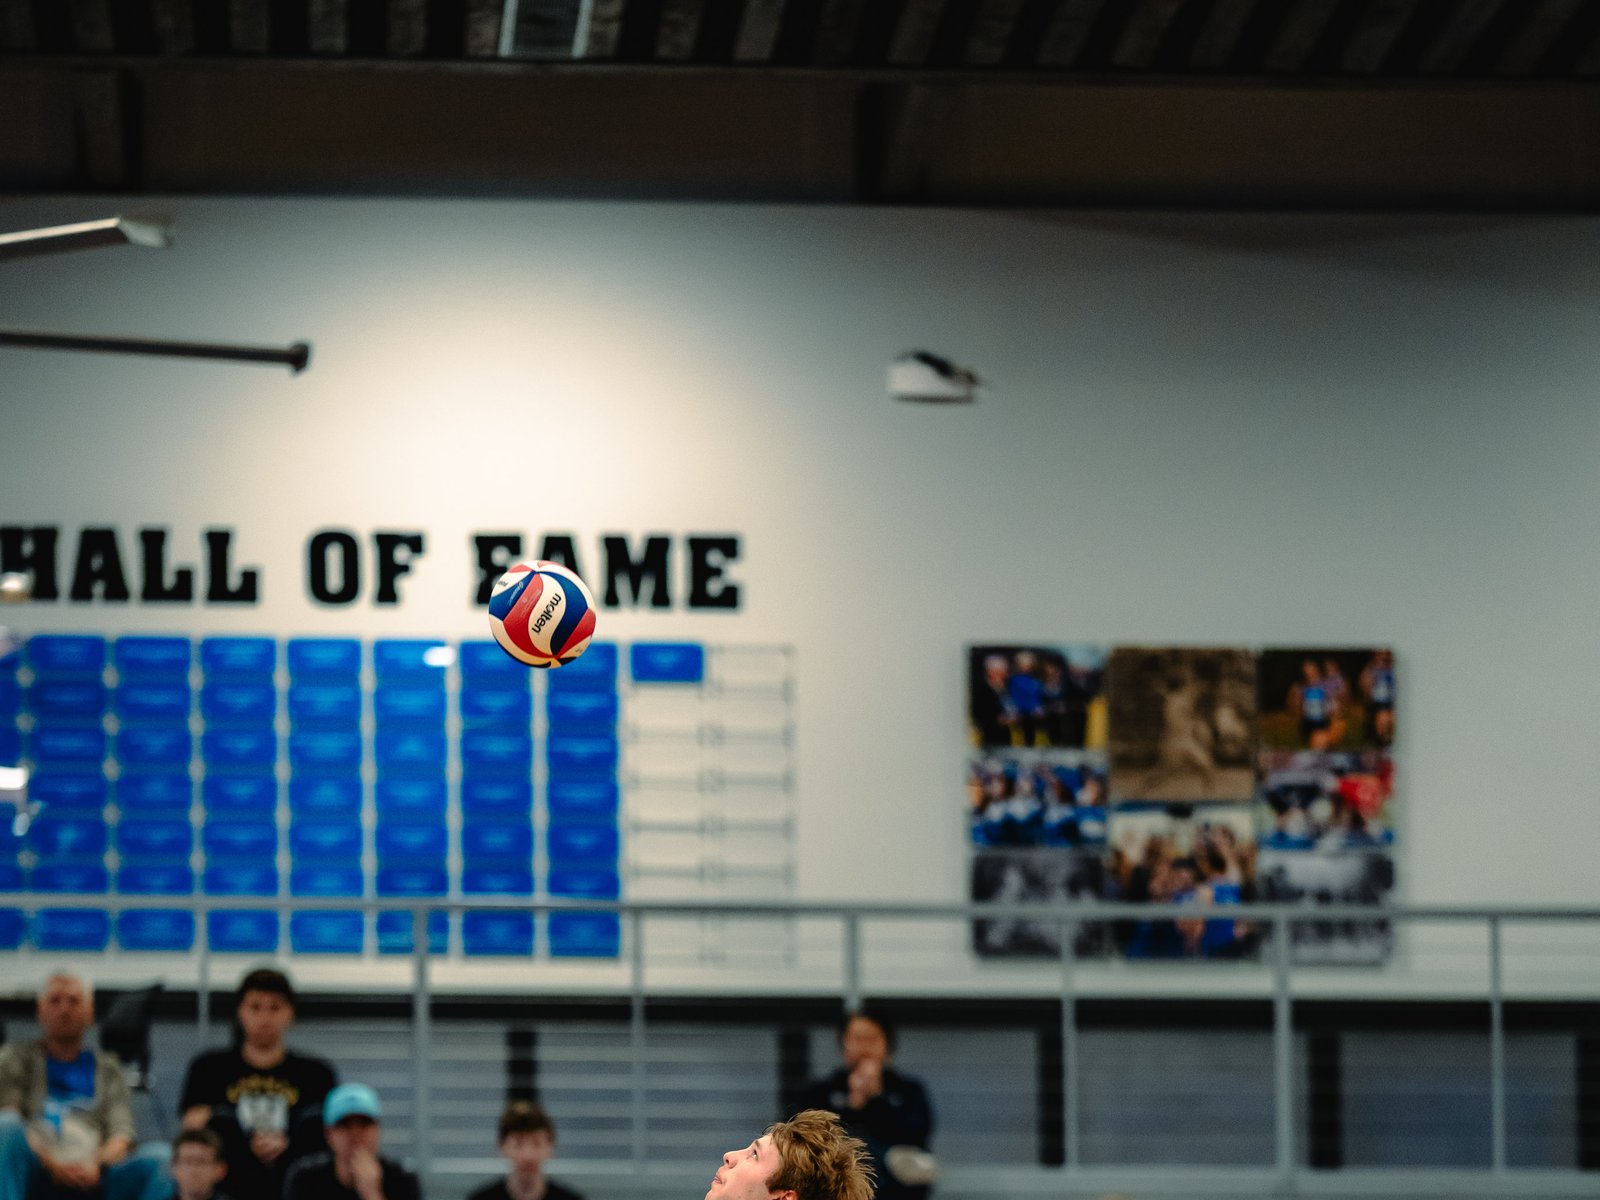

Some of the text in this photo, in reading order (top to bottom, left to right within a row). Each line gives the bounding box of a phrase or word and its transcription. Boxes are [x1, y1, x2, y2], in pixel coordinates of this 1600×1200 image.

[0, 526, 257, 603] HALL
[308, 531, 424, 605] OF
[531, 593, 562, 634] molten
